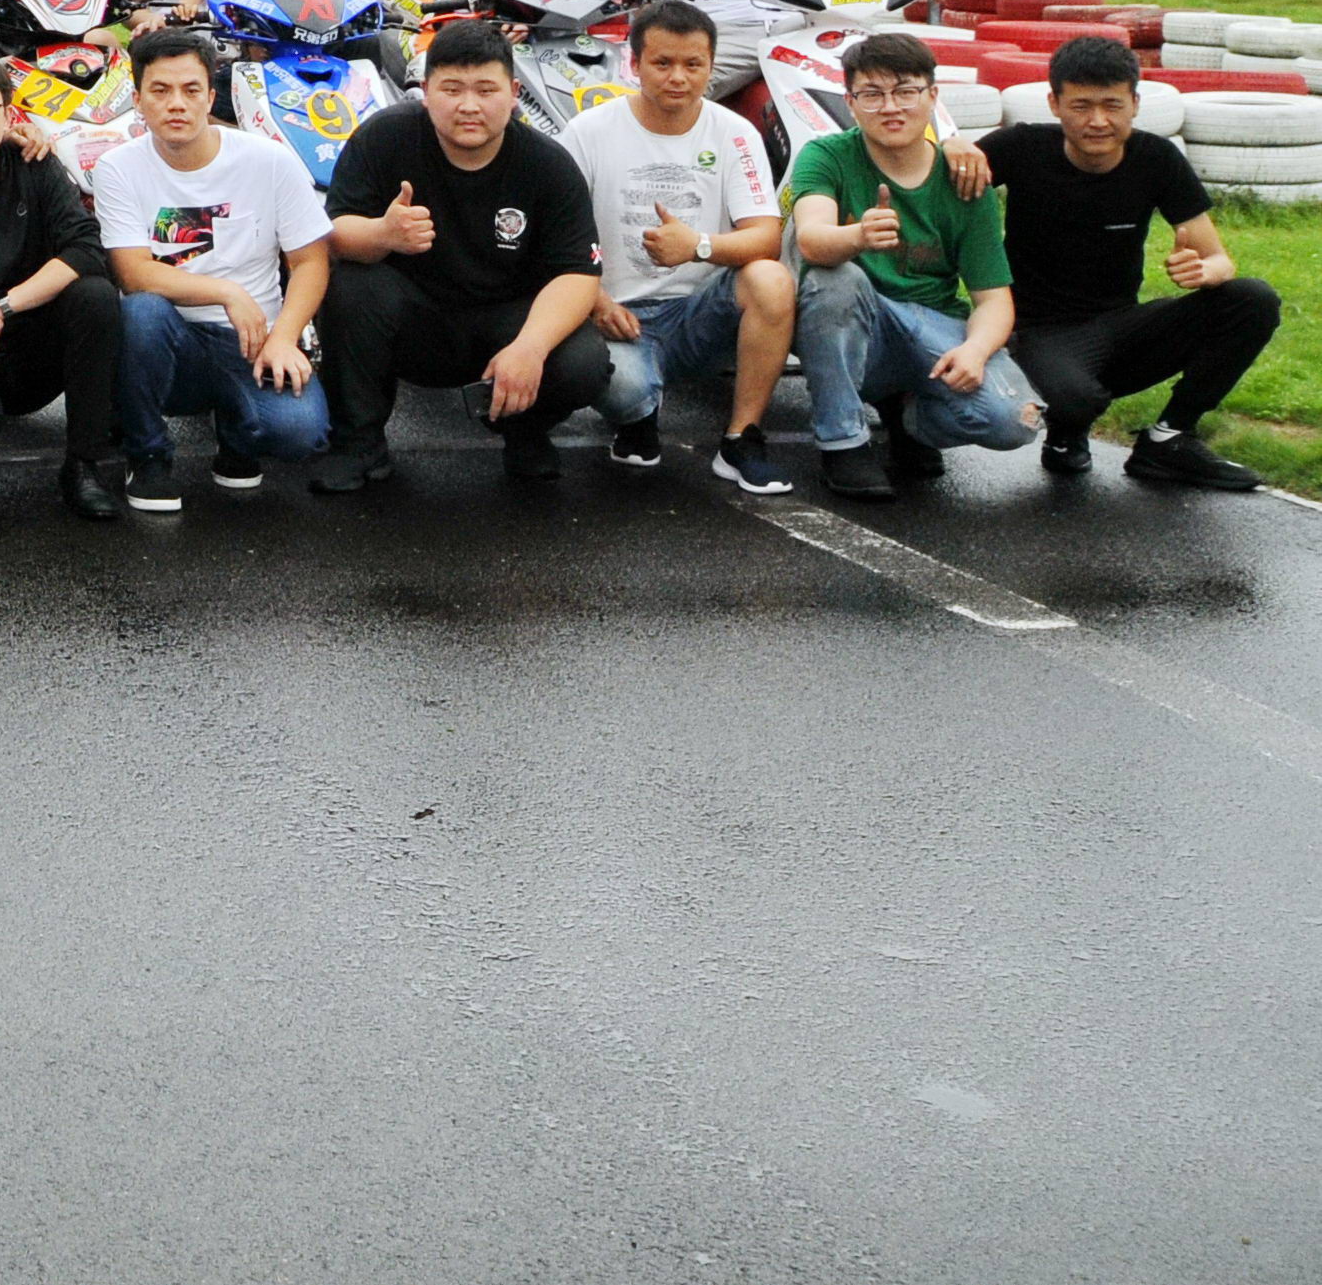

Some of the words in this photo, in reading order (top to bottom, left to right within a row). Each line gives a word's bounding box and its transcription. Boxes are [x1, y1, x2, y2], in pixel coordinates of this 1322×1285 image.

[292, 27, 339, 45] 兄弟车行
[21, 77, 74, 116] 24
[312, 91, 354, 136] 9
